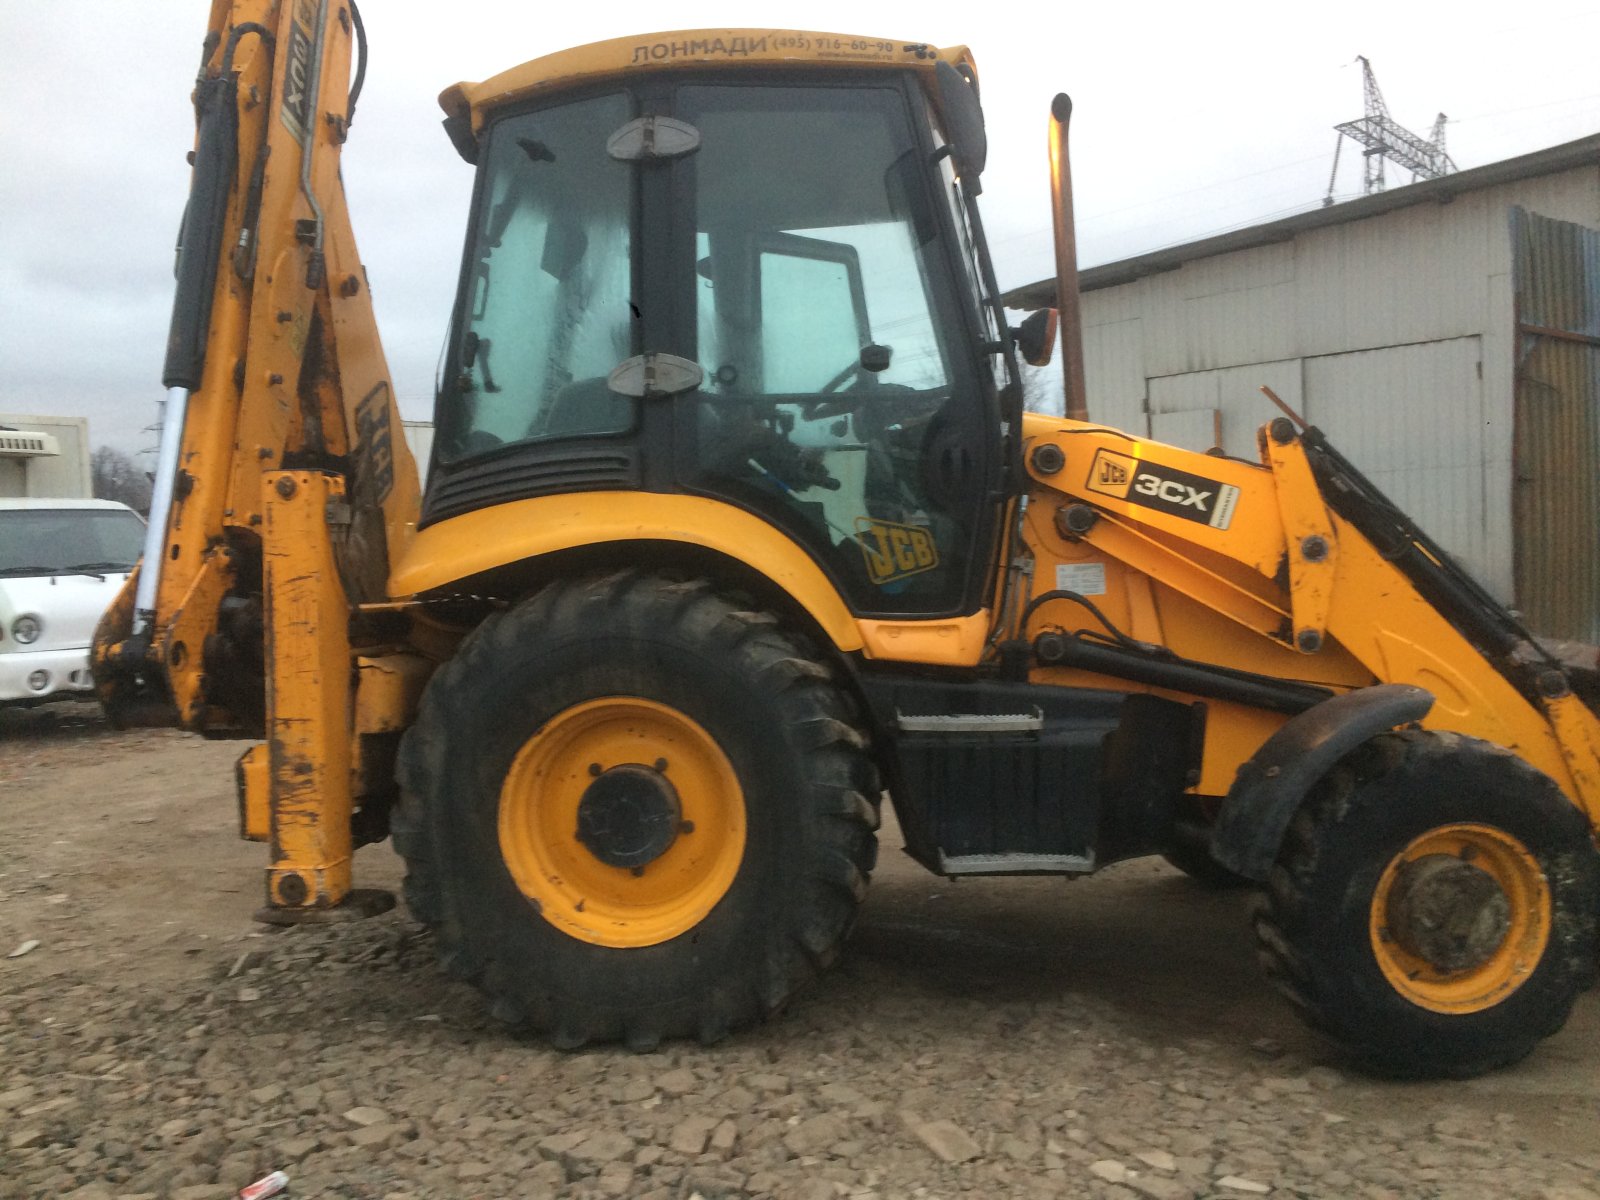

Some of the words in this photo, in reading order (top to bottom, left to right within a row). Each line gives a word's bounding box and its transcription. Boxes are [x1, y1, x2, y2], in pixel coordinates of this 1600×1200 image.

[632, 37, 767, 64] ЛОНМАДИ
[772, 37, 811, 51] (495)
[815, 38, 893, 53] 916-60-90
[1100, 460, 1126, 484] JCB
[1134, 473, 1212, 512] 3CX
[867, 524, 934, 577] JCB
